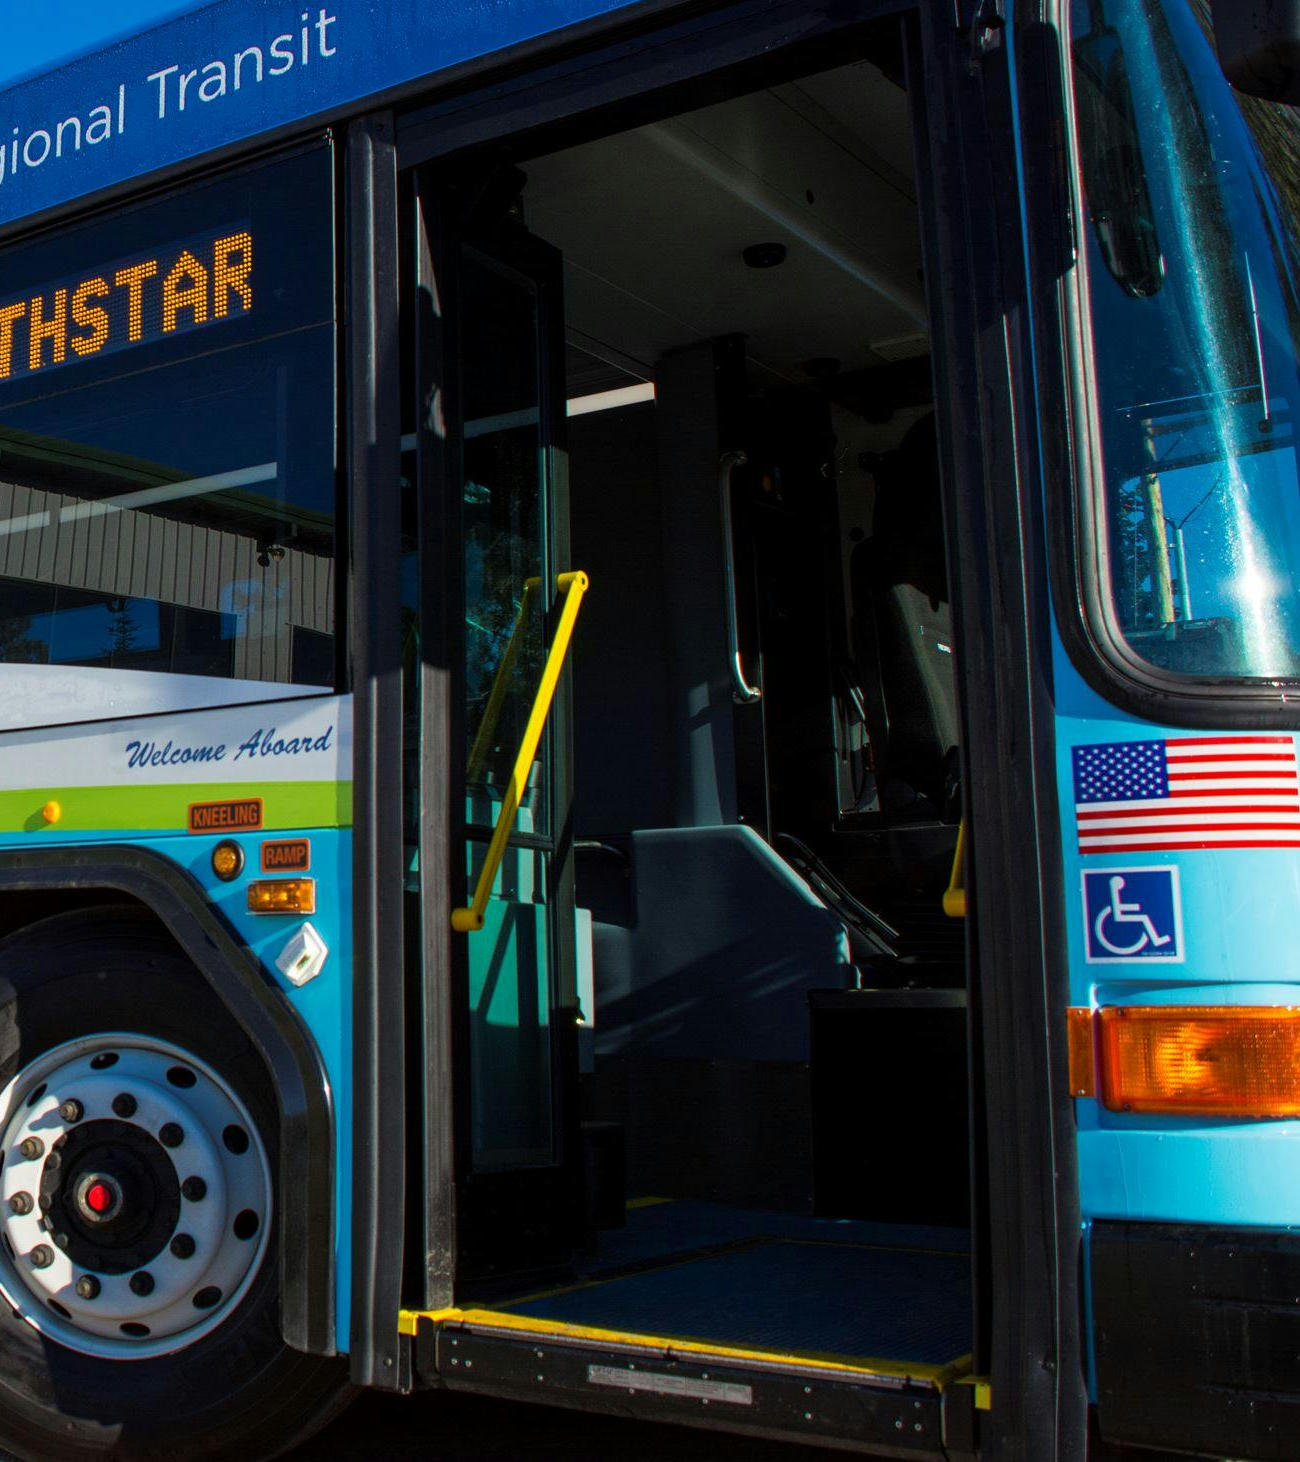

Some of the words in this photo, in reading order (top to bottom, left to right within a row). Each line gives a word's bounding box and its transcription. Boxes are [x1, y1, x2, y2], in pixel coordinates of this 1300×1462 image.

[147, 8, 337, 118] Transit
[125, 740, 228, 769] Welcome
[233, 725, 333, 762] Aboard
[193, 804, 258, 828] KNEELING
[266, 846, 306, 865] RAMP
